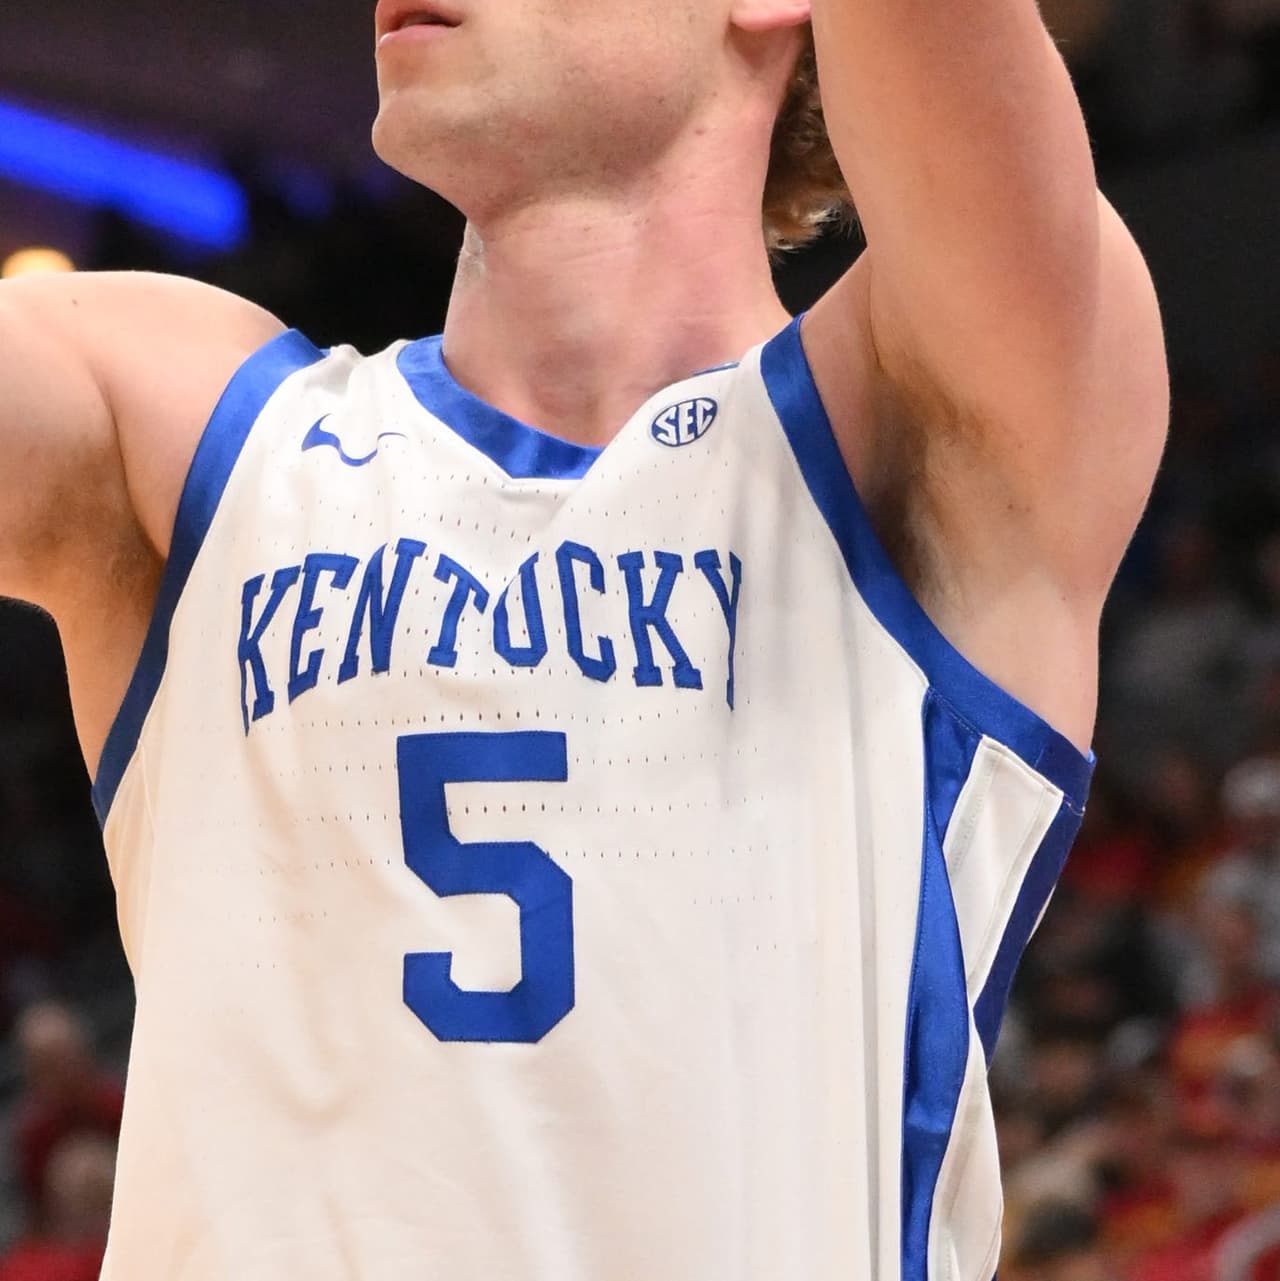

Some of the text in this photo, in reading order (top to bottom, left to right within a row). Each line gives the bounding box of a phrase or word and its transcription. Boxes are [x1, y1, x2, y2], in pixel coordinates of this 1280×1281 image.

[652, 397, 716, 447] SEC
[237, 537, 742, 736] KENTUCKY
[396, 730, 575, 1043] 5
